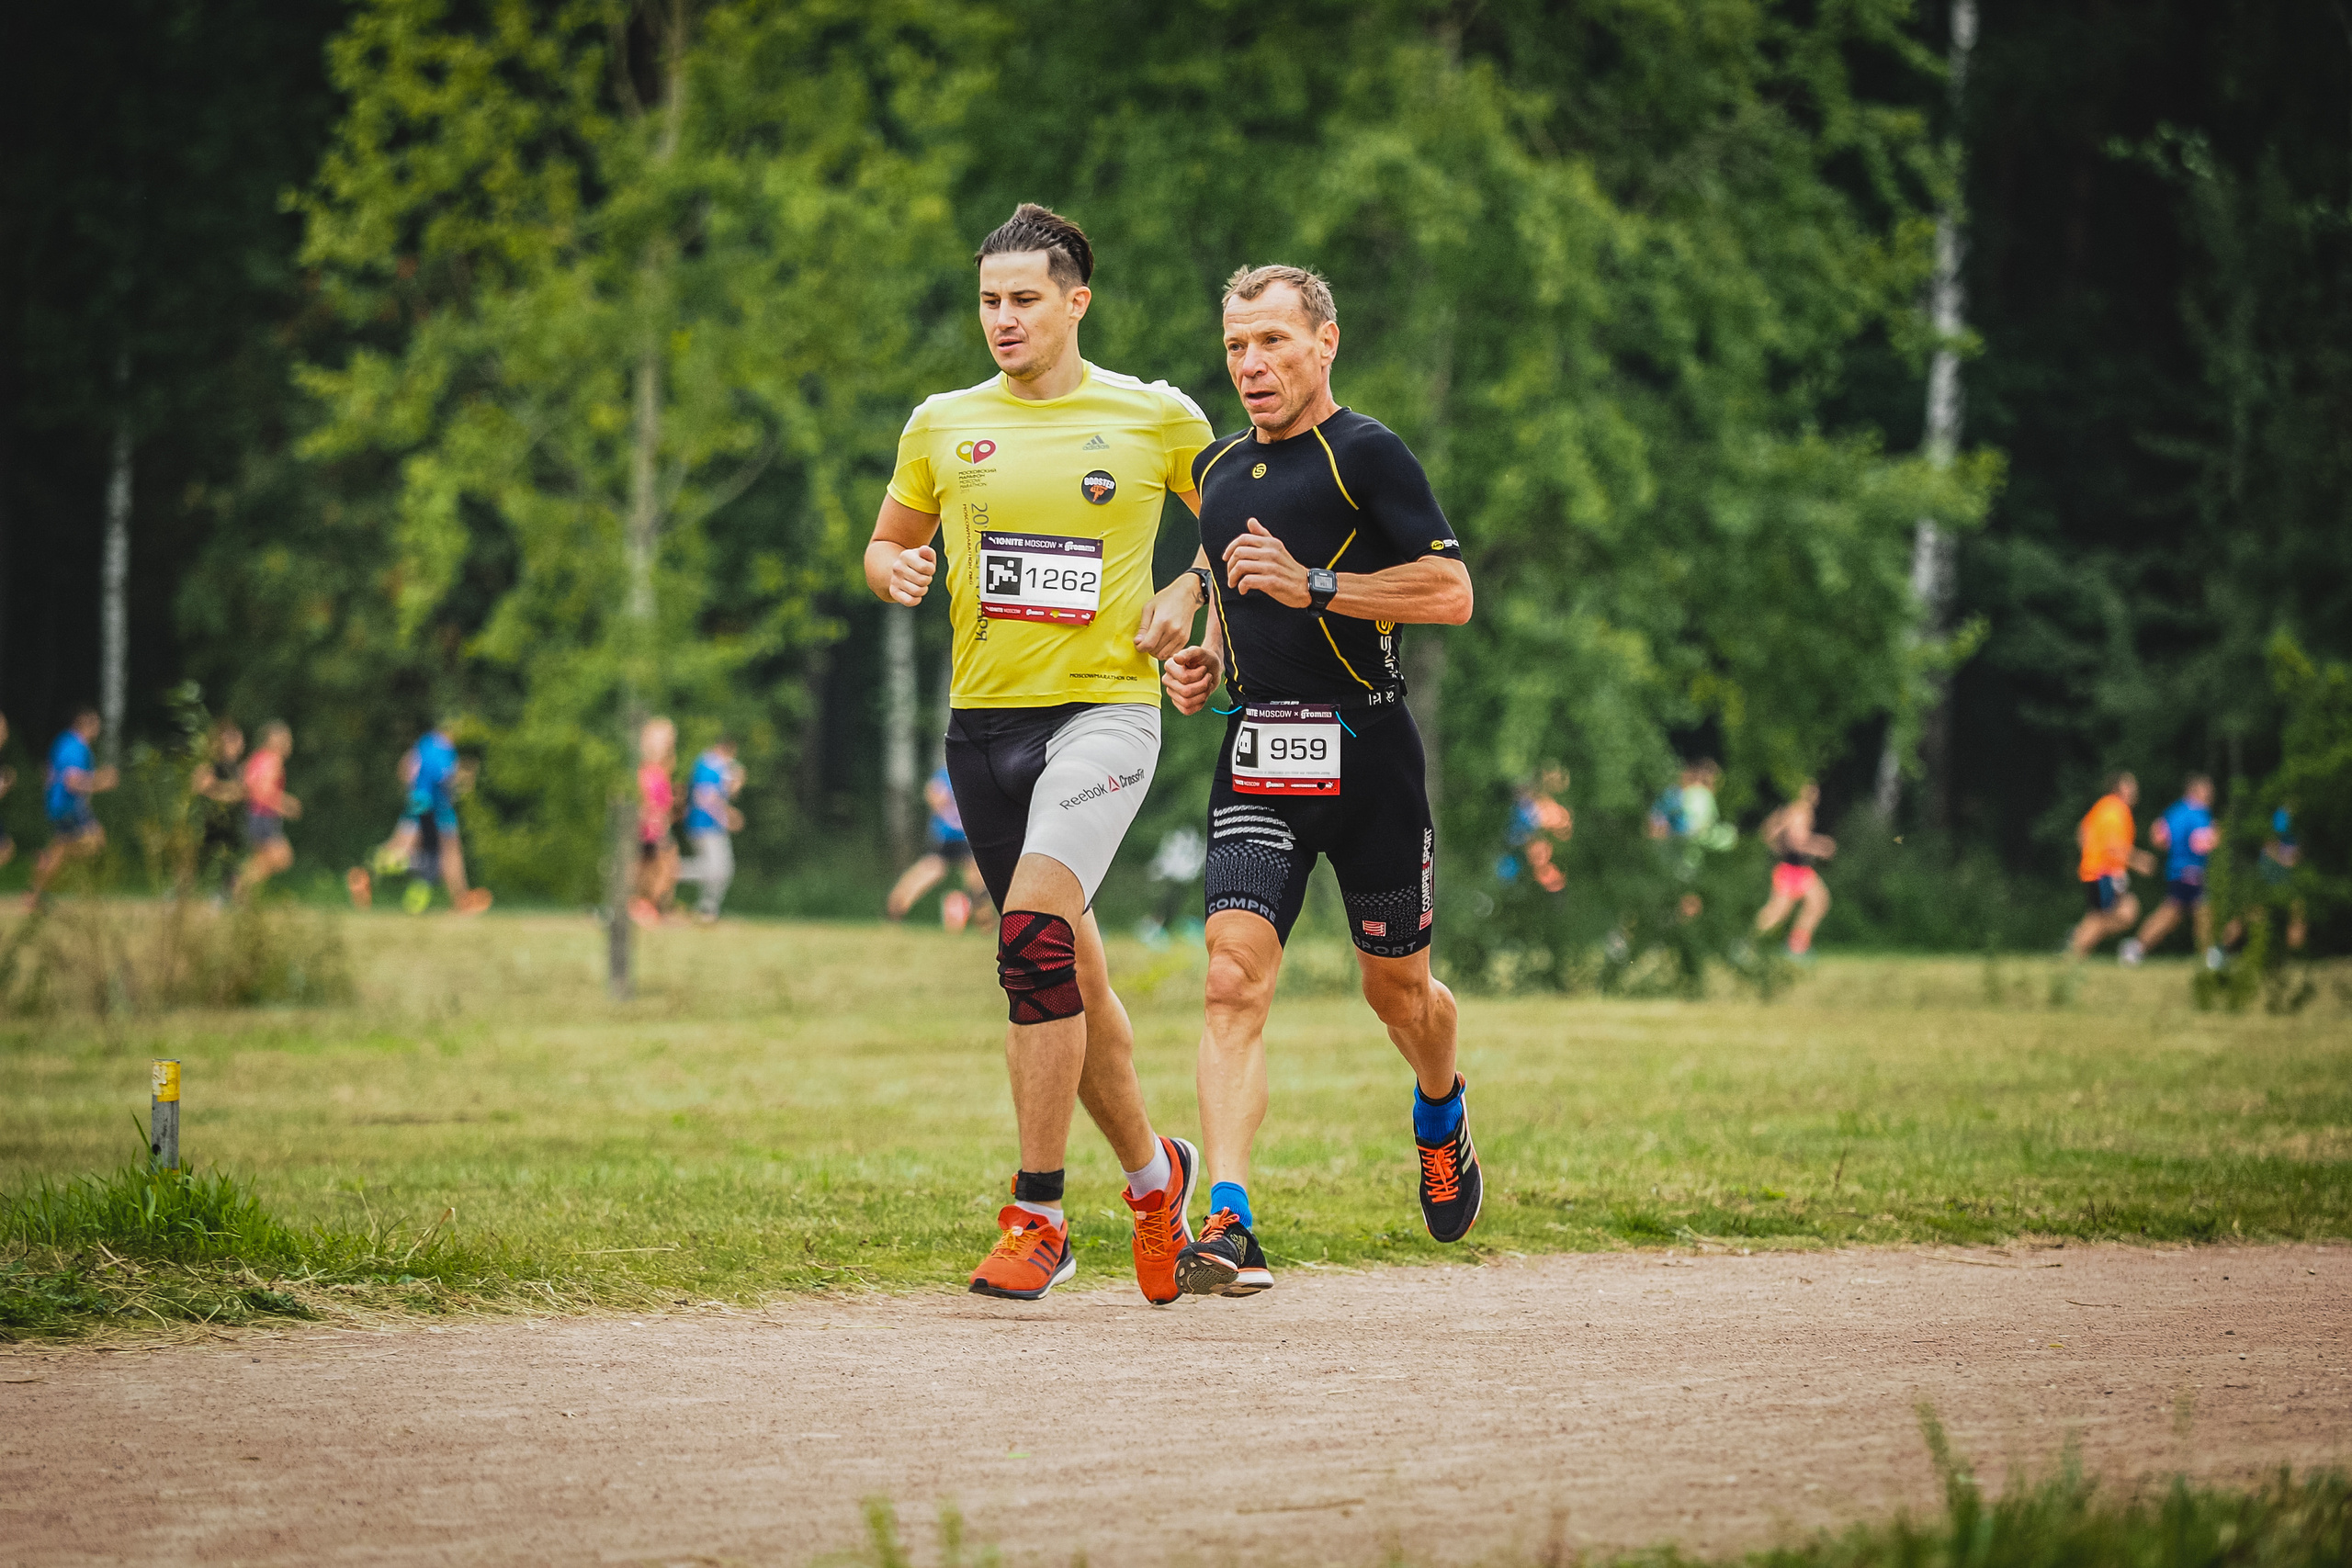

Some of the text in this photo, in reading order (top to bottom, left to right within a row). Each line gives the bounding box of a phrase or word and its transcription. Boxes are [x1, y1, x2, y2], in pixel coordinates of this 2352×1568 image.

[994, 537, 1023, 547] IGNITE
[1024, 539, 1057, 549] MOSCOW
[1025, 567, 1097, 593] 1262
[1270, 738, 1328, 761] 959
[1059, 768, 1145, 810] Reebok CrossFit
[1208, 897, 1276, 923] COMPRE
[1354, 935, 1417, 955] SPORT
